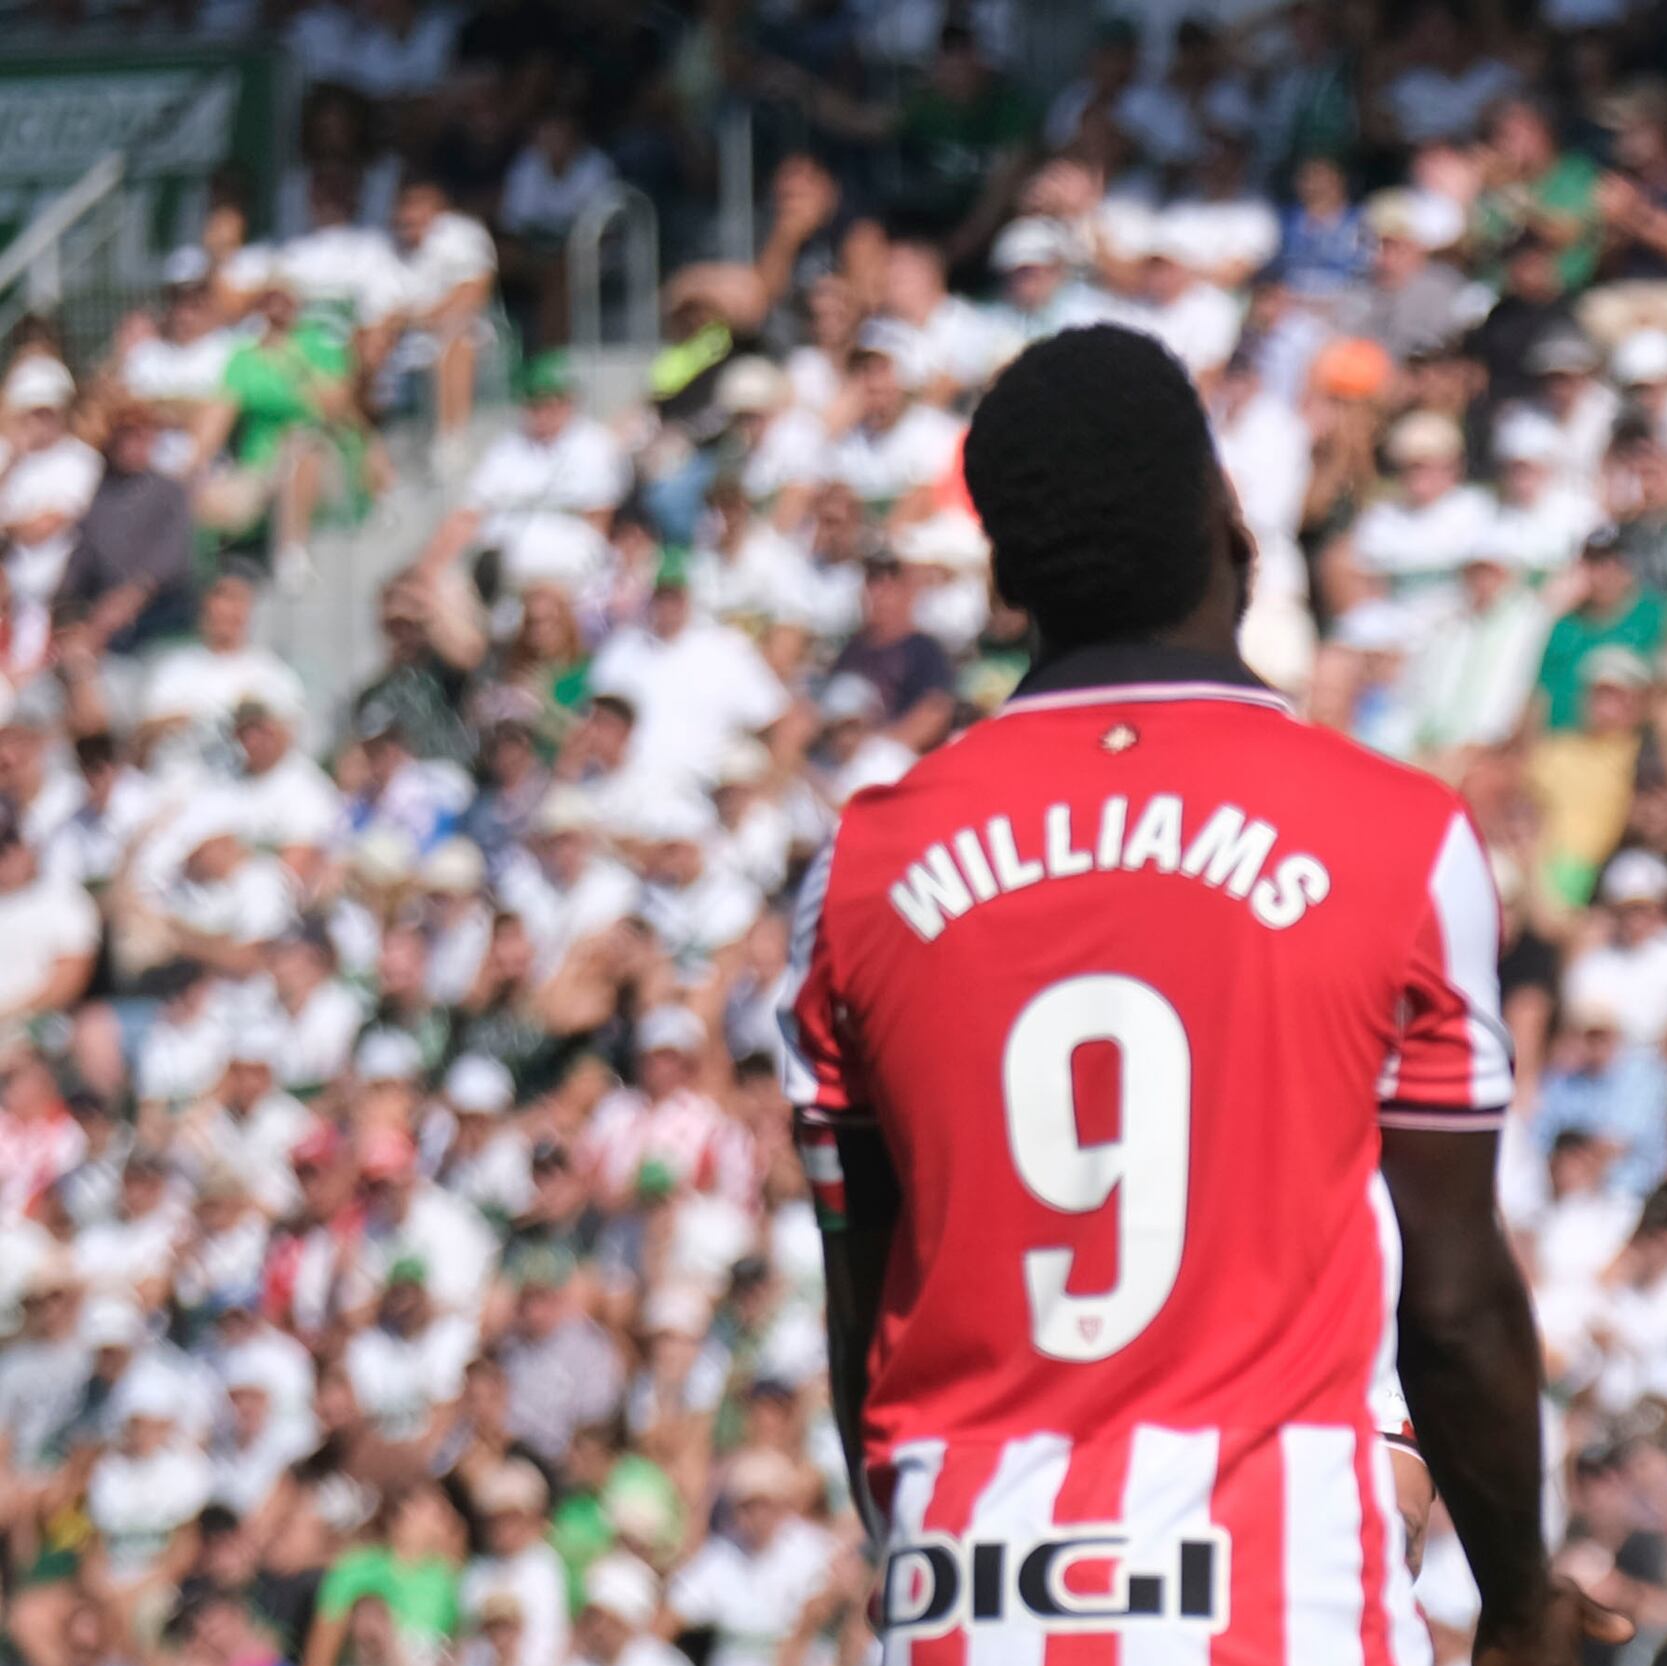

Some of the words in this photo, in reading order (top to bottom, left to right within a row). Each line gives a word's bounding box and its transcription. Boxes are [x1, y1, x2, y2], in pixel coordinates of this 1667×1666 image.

[888, 795, 1331, 943] WILLIAMS
[1002, 973, 1192, 1362] 9
[886, 1538, 1214, 1627] DIGI
